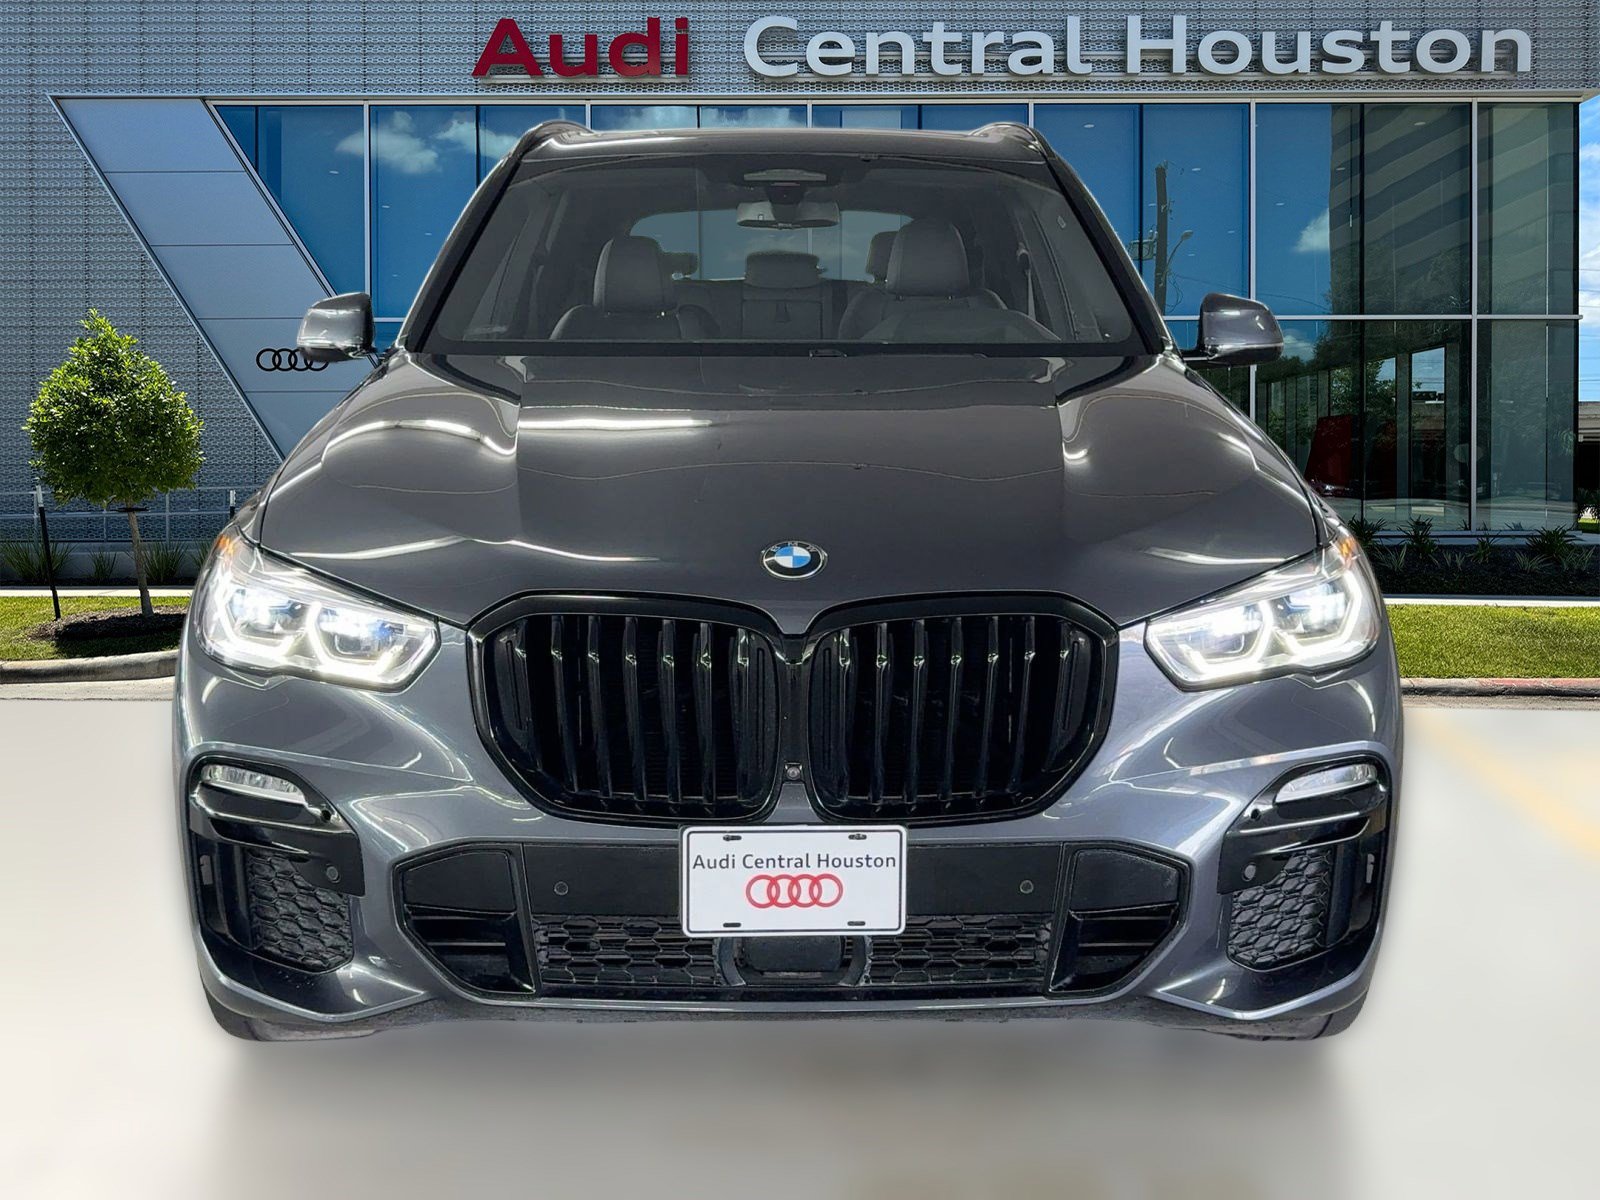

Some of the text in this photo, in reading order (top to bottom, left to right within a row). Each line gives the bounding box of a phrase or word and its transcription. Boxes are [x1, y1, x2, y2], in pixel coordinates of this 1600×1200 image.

[472, 15, 1532, 77] Audi Central Houston
[692, 853, 897, 869] Audi Central Houston
